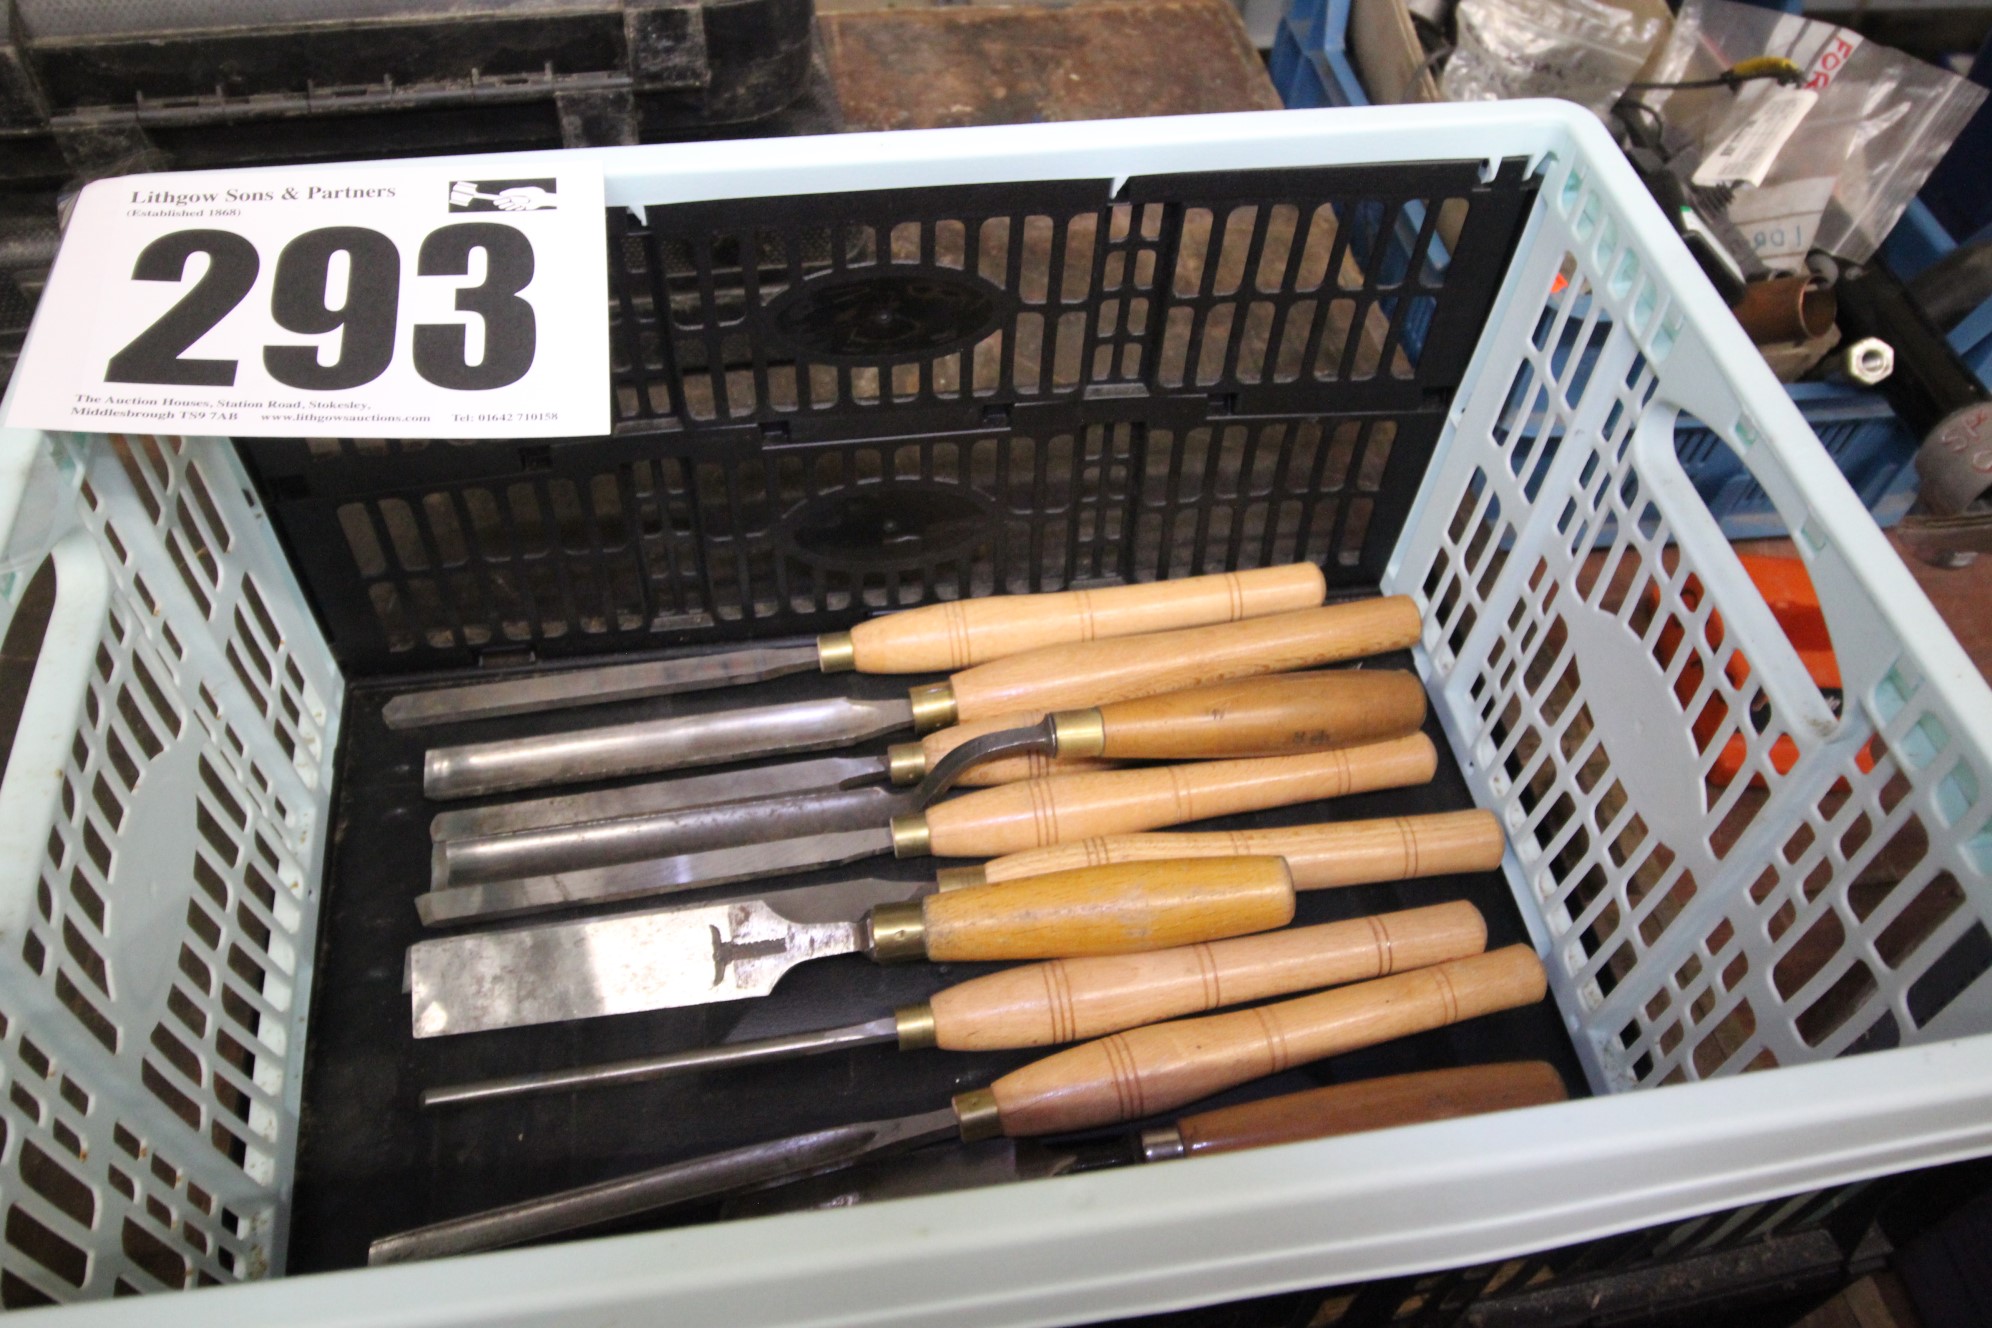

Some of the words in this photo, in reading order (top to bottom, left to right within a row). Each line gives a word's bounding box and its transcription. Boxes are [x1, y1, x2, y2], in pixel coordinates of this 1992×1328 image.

[130, 190, 218, 206] Lithgow
[225, 188, 274, 203] Sons
[281, 187, 299, 200] &
[308, 186, 396, 200] Partners
[126, 208, 204, 218] (Established
[208, 208, 241, 218] 1868)
[103, 222, 536, 391] 293
[75, 394, 101, 404] The
[105, 396, 158, 406] Auction
[162, 398, 213, 408] Houses,
[217, 399, 263, 409] Station
[268, 400, 305, 410] Road,
[309, 401, 371, 411] Stokesley,
[71, 407, 175, 421] Middlesbrough
[180, 410, 206, 420] TS9
[261, 412, 431, 423] www.lithgowsauctions.com
[452, 413, 474, 422] Tel:
[478, 413, 513, 422] 01642
[518, 412, 559, 422] 710158
